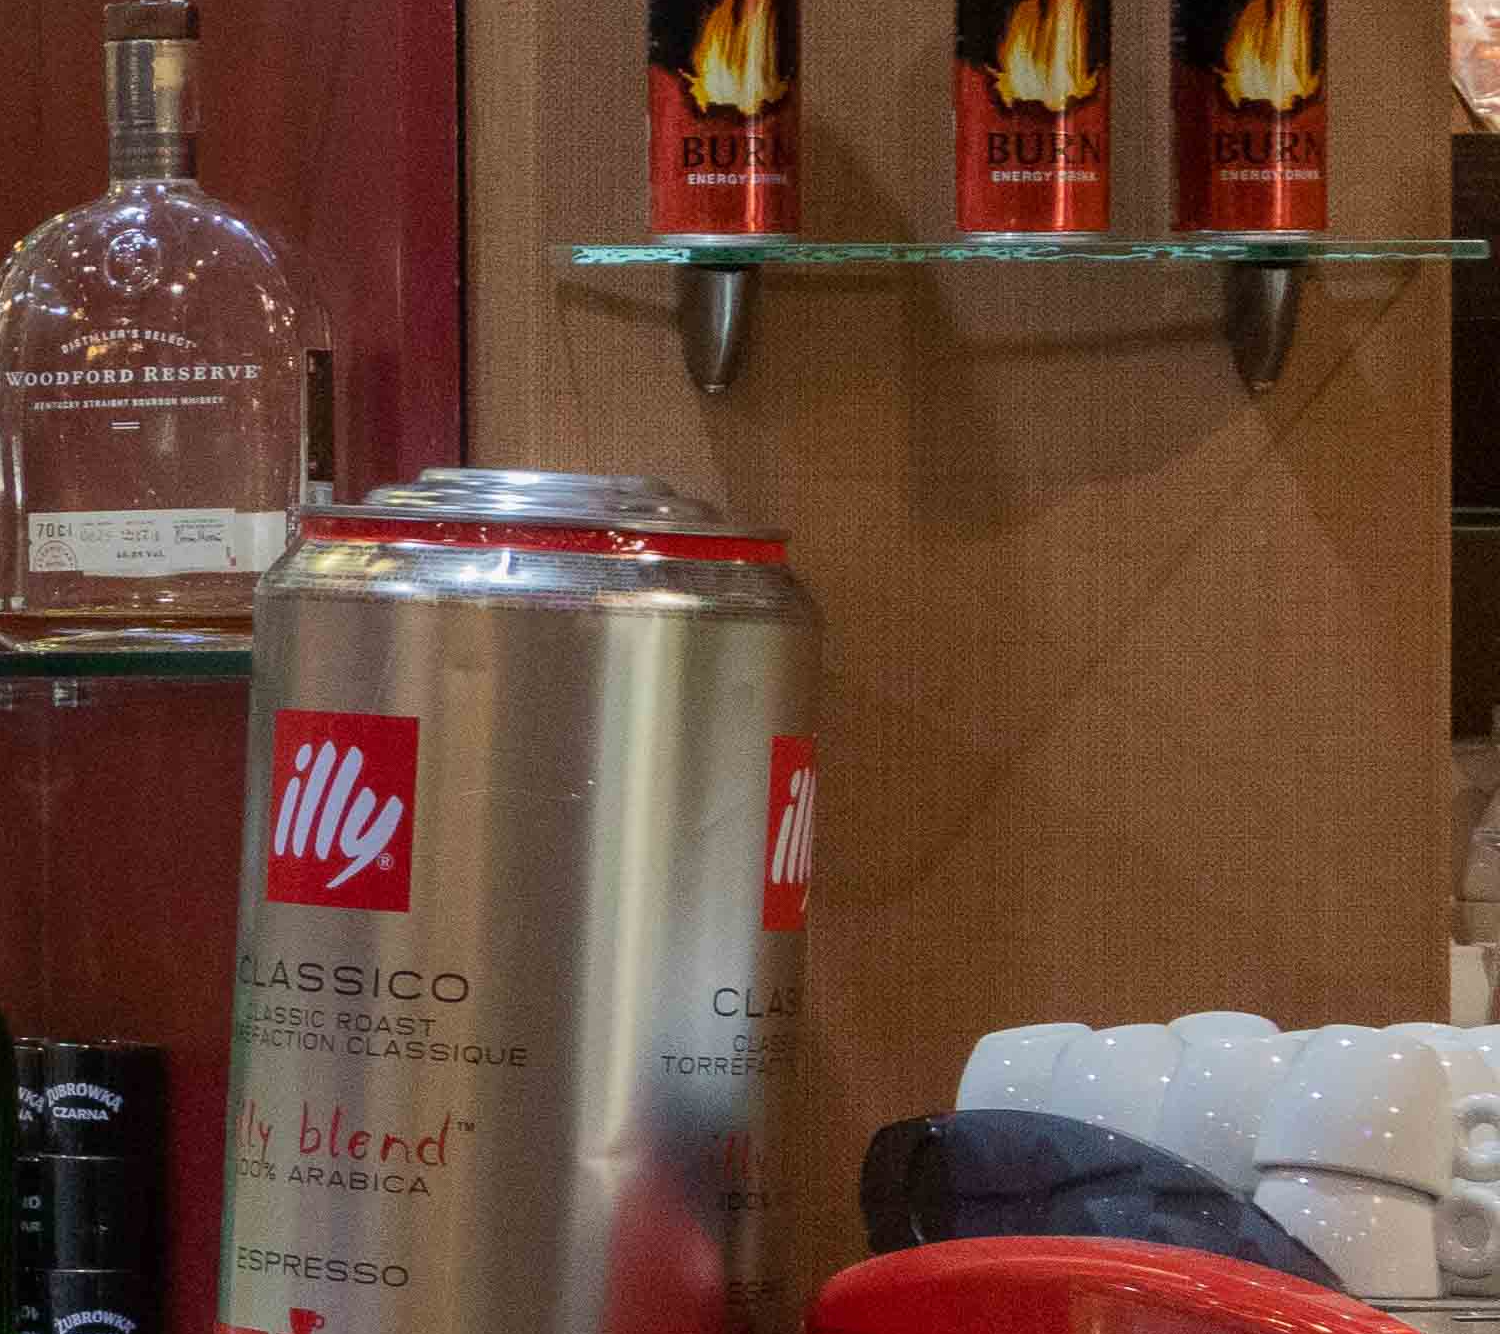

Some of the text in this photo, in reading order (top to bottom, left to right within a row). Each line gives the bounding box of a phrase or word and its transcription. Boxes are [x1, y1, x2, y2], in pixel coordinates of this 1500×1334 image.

[686, 171, 749, 187] ENERGY
[990, 169, 1054, 184] ENERGY
[1219, 169, 1275, 184] ENERGY
[147, 330, 197, 350] SELECT
[4, 364, 261, 388] WOODFORD RESERVE
[273, 738, 405, 888] illy
[338, 1012, 437, 1039] ROAST
[346, 1036, 529, 1067] CLASSIQUE
[51, 1106, 109, 1121] CZARNA
[299, 1099, 452, 1166] blend
[287, 1165, 432, 1197] ARABICA
